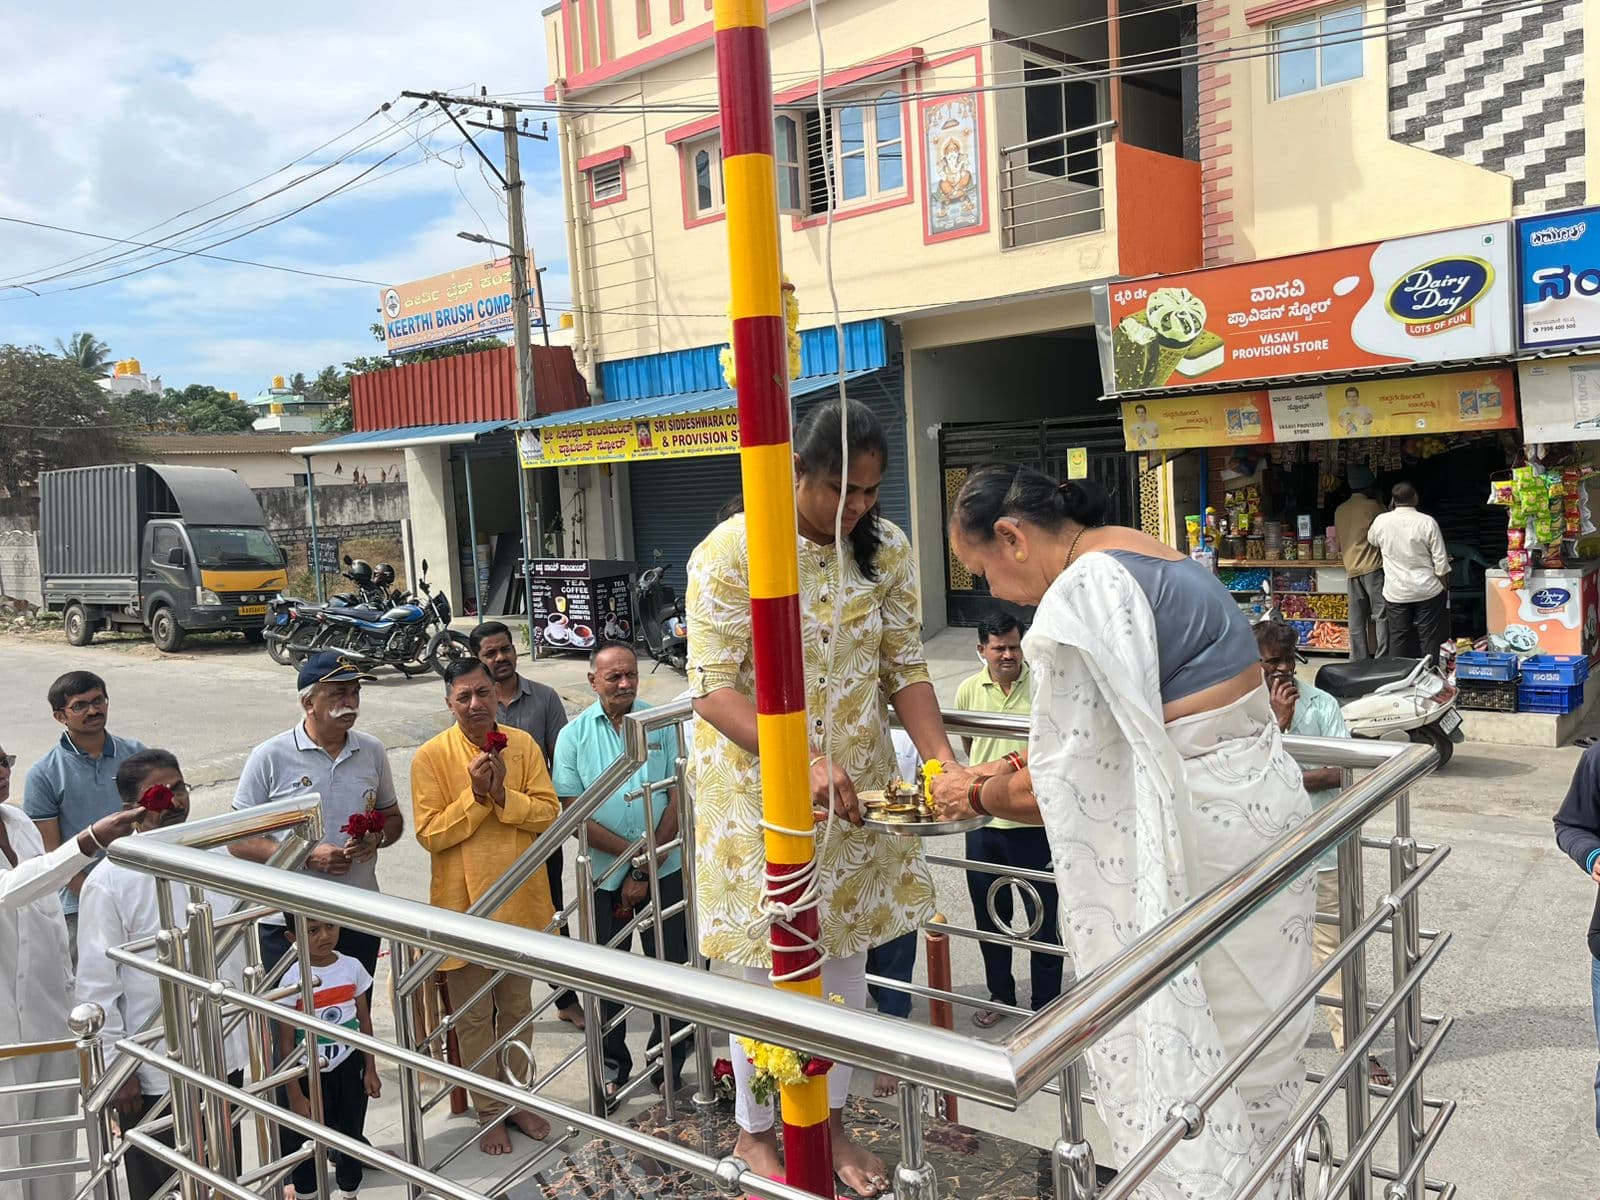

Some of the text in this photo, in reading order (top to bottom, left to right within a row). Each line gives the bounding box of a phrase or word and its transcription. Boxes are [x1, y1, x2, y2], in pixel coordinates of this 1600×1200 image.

[1250, 279, 1305, 303] ವಾಸವಿ
[1404, 270, 1471, 293] Dairy
[1412, 289, 1462, 314] Day
[387, 311, 433, 339] KEERTHI
[436, 303, 474, 328] BRUSH
[477, 288, 535, 318] COMPY
[1227, 298, 1332, 328] ಪ್ರಾವಿಷನ್ ಸ್ಟೋರ್
[1410, 313, 1467, 334] LOTS OF FUN
[1259, 331, 1299, 345] VASAVI
[1232, 339, 1329, 360] PROVISION STORE
[654, 420, 667, 433] SRI
[669, 414, 724, 431] SIDDESHWARA
[662, 436, 669, 448] &
[672, 431, 728, 447] PROVISION
[561, 586, 589, 594] COFFEE
